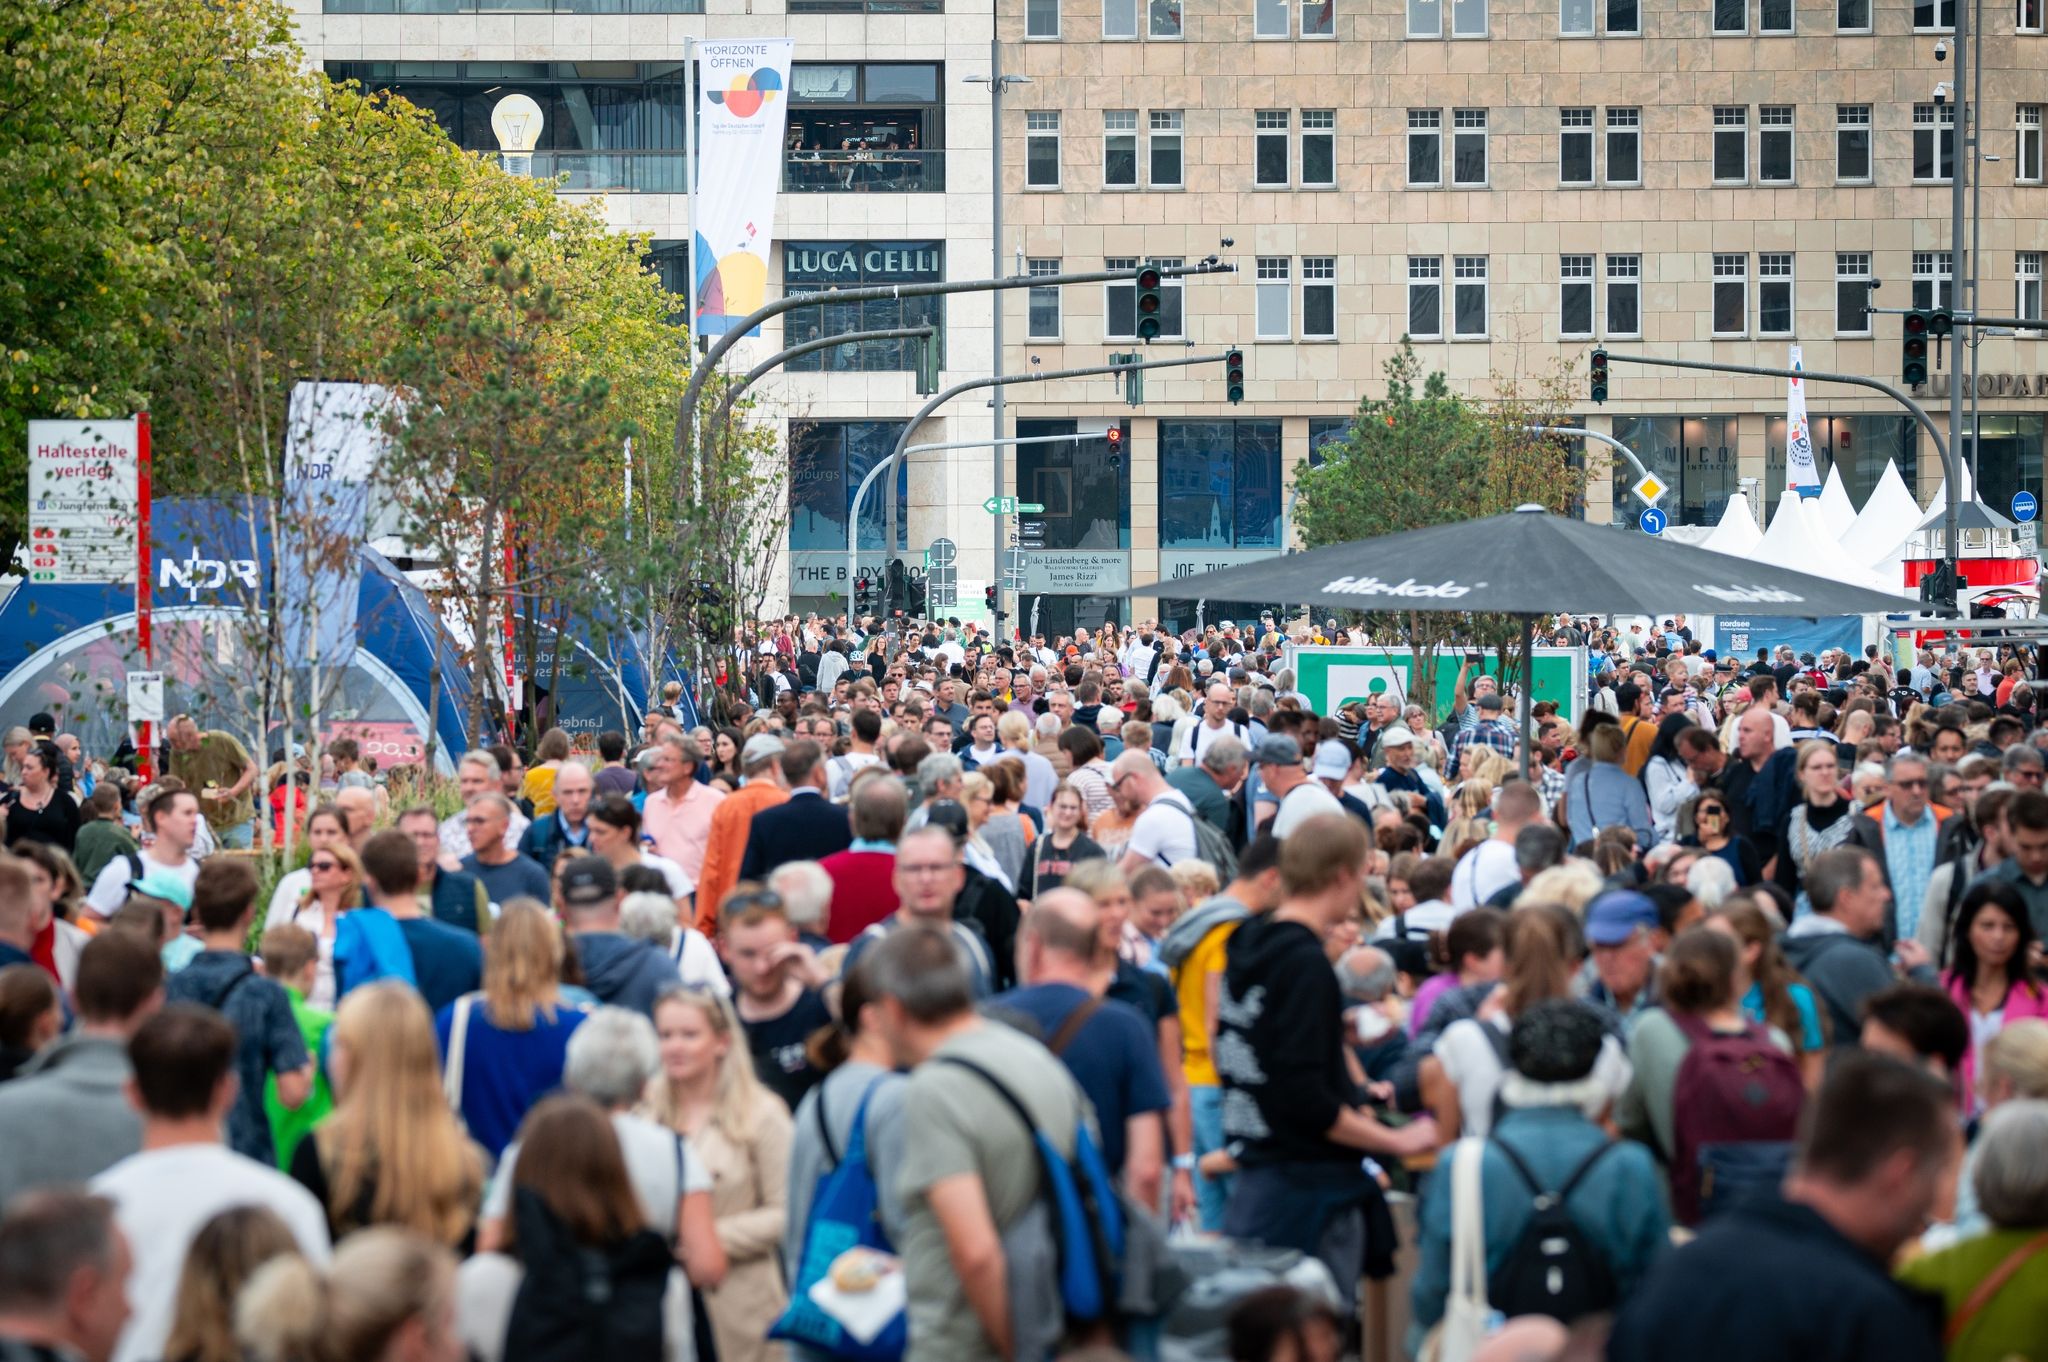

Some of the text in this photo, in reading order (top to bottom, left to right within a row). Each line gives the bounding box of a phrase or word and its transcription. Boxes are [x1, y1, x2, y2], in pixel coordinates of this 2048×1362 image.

[705, 45, 767, 55] HORIZONTE
[710, 56, 754, 68] ÖFFNEN
[788, 250, 858, 273] LUCA
[864, 250, 938, 273] CELLI
[37, 444, 127, 458] Haltestelle
[56, 463, 113, 480] verlegt
[296, 463, 333, 480] NDR
[58, 501, 128, 512] Jungfernseg
[1045, 556, 1089, 565] Lindenberg
[1091, 556, 1099, 564] &
[159, 557, 258, 590] NDR
[798, 567, 830, 580] THE
[836, 567, 882, 580] BDY
[1050, 573, 1074, 581] James
[1172, 564, 1195, 579] JOE
[1720, 620, 1750, 628] nordsee
